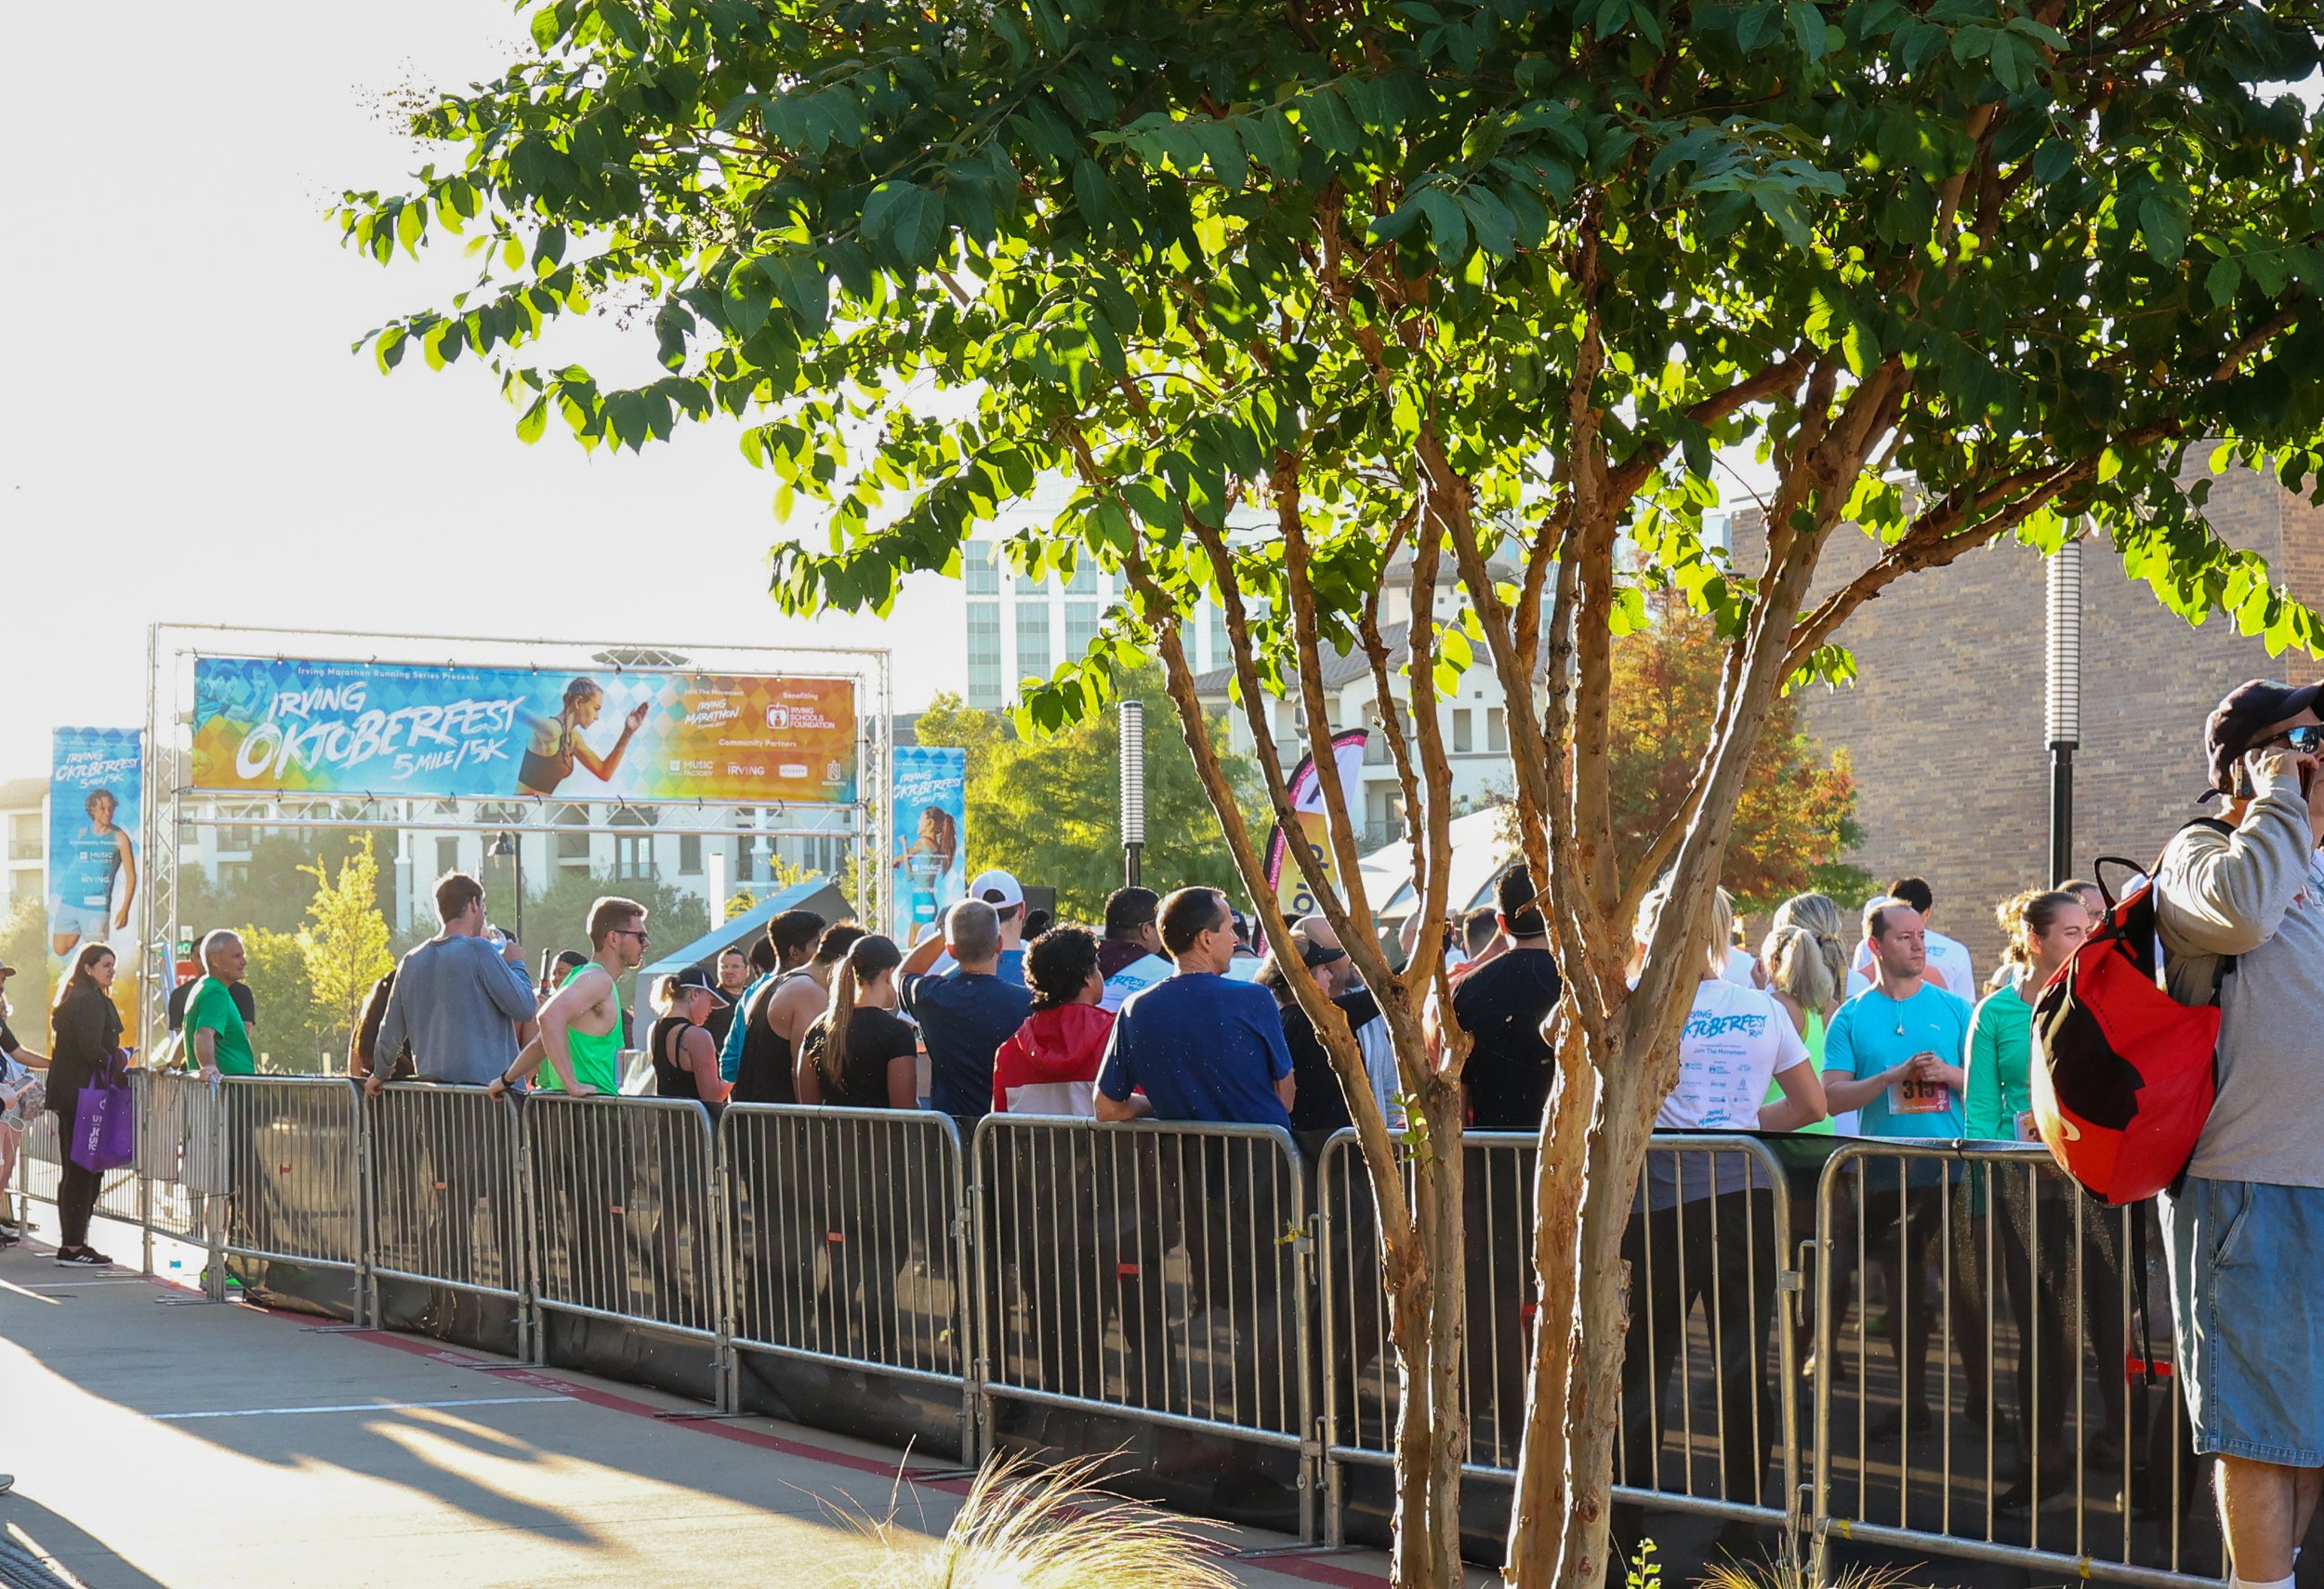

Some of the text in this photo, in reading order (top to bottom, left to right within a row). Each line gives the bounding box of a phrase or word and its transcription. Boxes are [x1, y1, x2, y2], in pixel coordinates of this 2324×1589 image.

[297, 667, 324, 677] Irving
[327, 668, 370, 677] Marathon
[374, 669, 410, 679] Running
[442, 673, 480, 682] Presents
[267, 681, 368, 722] IRVING
[783, 692, 818, 701] Benefiting
[697, 698, 726, 711] IRVING
[789, 707, 814, 715] IRVING
[684, 706, 740, 725] MARATHON
[789, 714, 825, 722] SCHOOLS
[235, 695, 526, 780] OKTOBERFEST
[718, 738, 763, 748] Community
[66, 748, 104, 764] IRVING
[56, 758, 139, 782] OKTOBERFEST
[683, 761, 713, 770] MUSIC
[728, 765, 765, 775] IRVING
[899, 770, 932, 784] IRVING
[893, 777, 963, 800] OKTOBERFEST
[1681, 1013, 1767, 1041] KTOBERFEST
